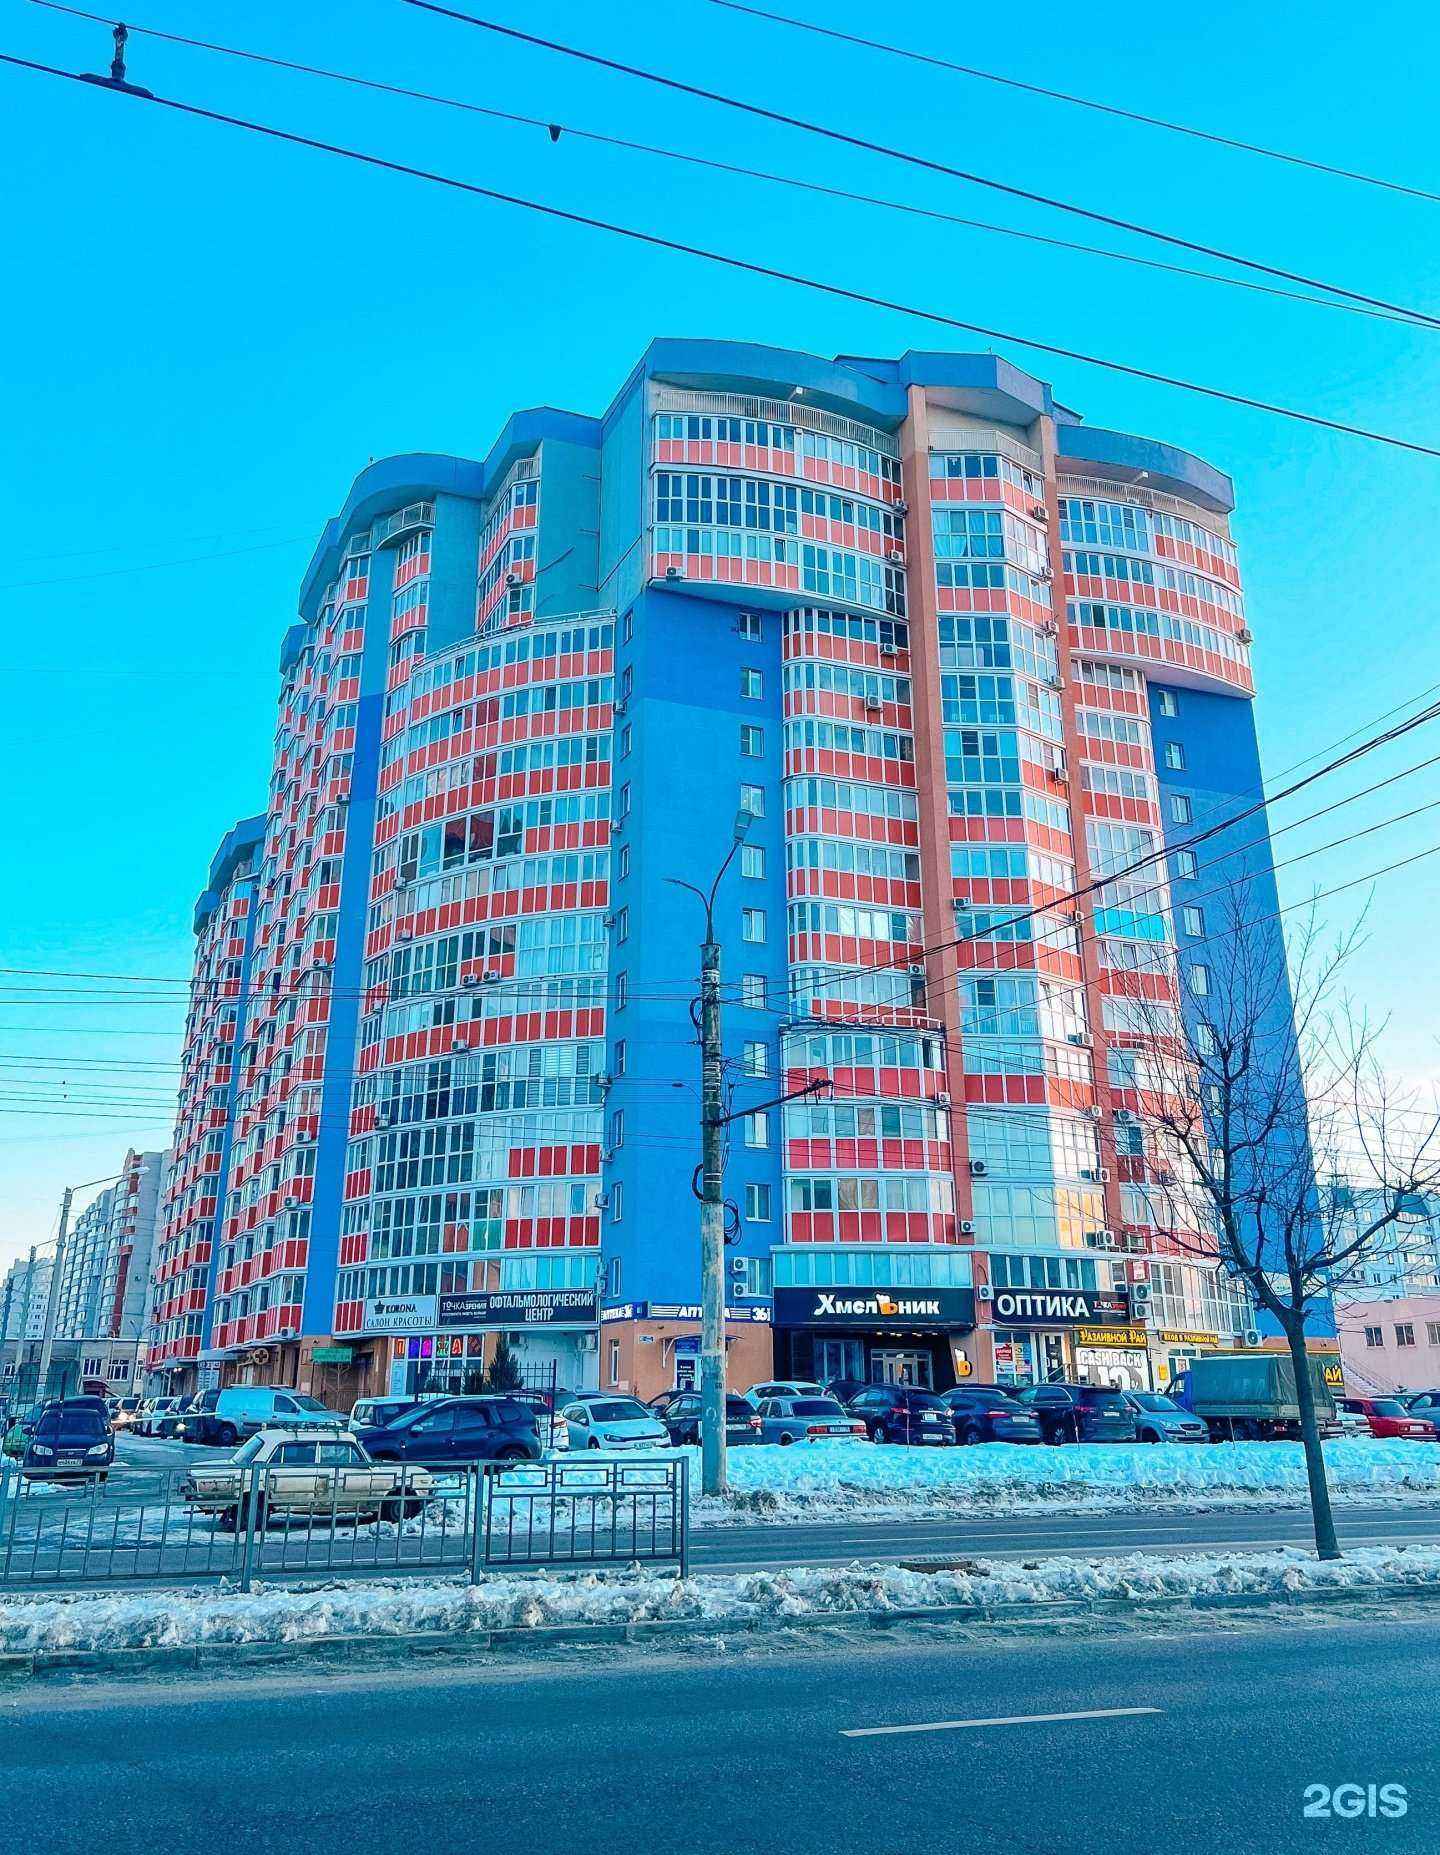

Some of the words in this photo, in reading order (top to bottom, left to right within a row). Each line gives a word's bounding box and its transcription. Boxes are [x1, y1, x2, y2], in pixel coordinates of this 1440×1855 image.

[489, 1290, 594, 1309] ОФТАЛЬМОЛОГИЧЕСКИЙ
[997, 1295, 1090, 1317] ОПТИКА
[525, 1307, 554, 1323] ЦЕНТР
[679, 1306, 730, 1319] АПТА
[393, 1316, 432, 1327] КРАСОТЫ
[1325, 1365, 1342, 1381] АЙ
